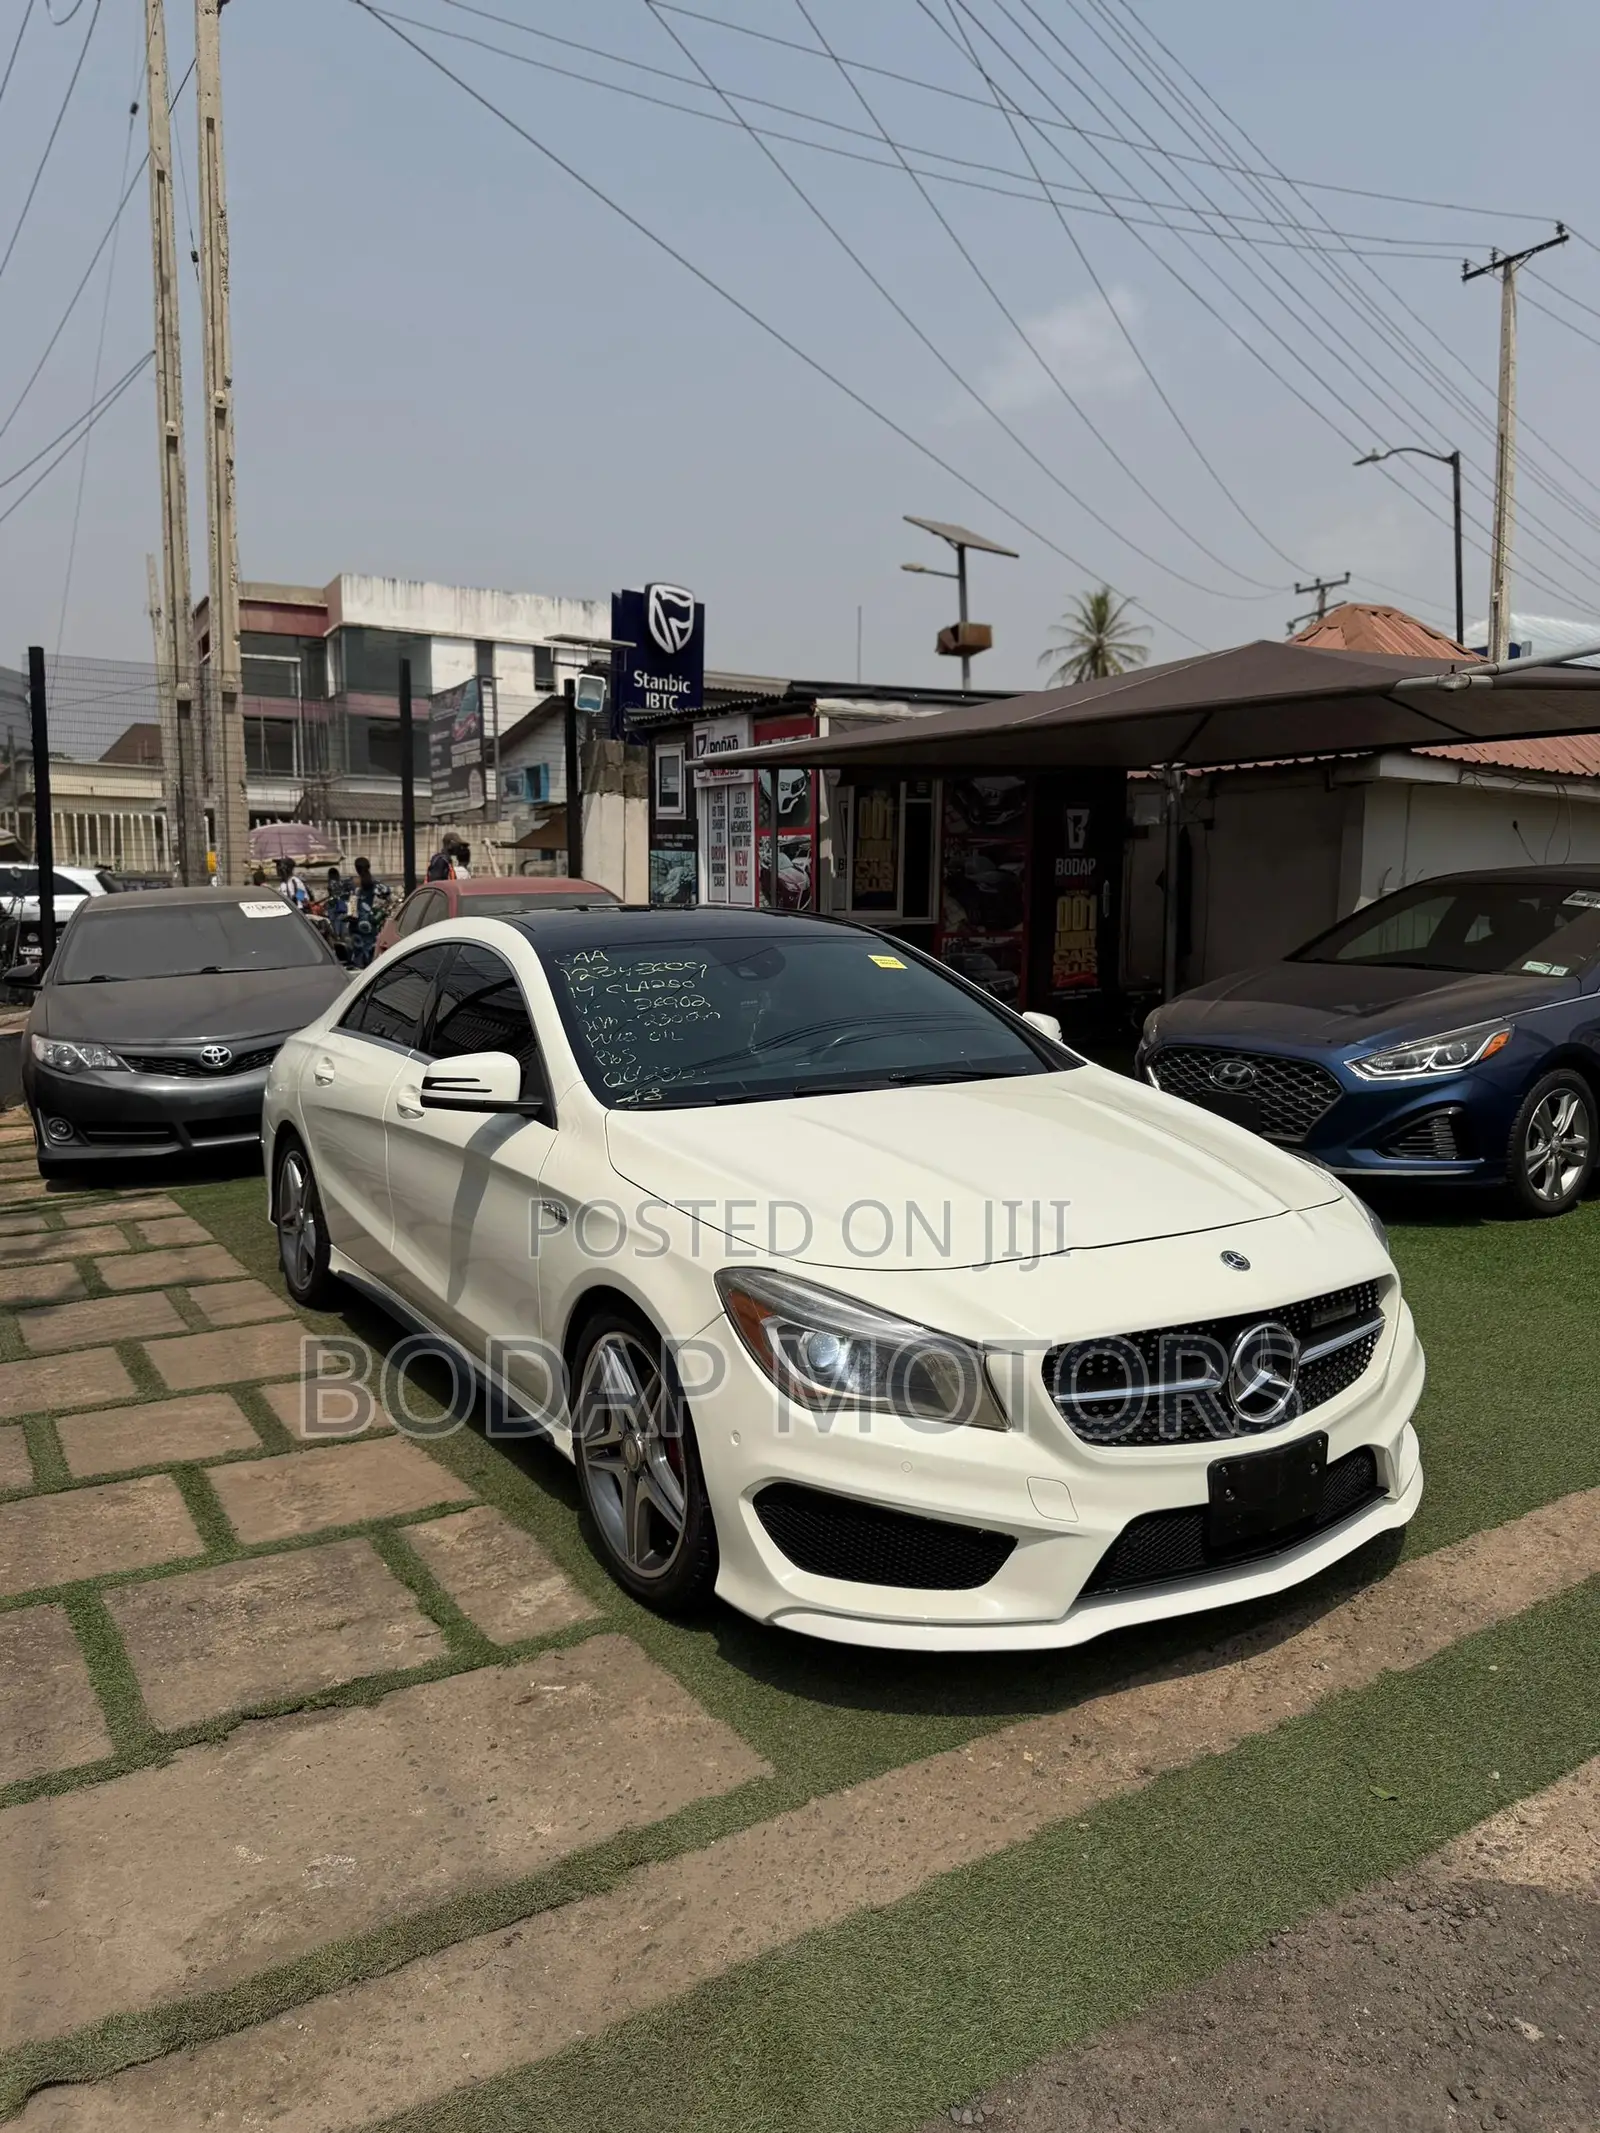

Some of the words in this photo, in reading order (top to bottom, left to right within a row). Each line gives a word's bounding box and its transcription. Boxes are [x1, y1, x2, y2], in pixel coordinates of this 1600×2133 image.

[633, 670, 691, 693] Stanbic
[645, 692, 679, 710] IBTC
[733, 806, 748, 818] CREATE
[734, 850, 749, 866] NEW
[1055, 858, 1096, 875] BODAP
[734, 870, 749, 887] RIDE
